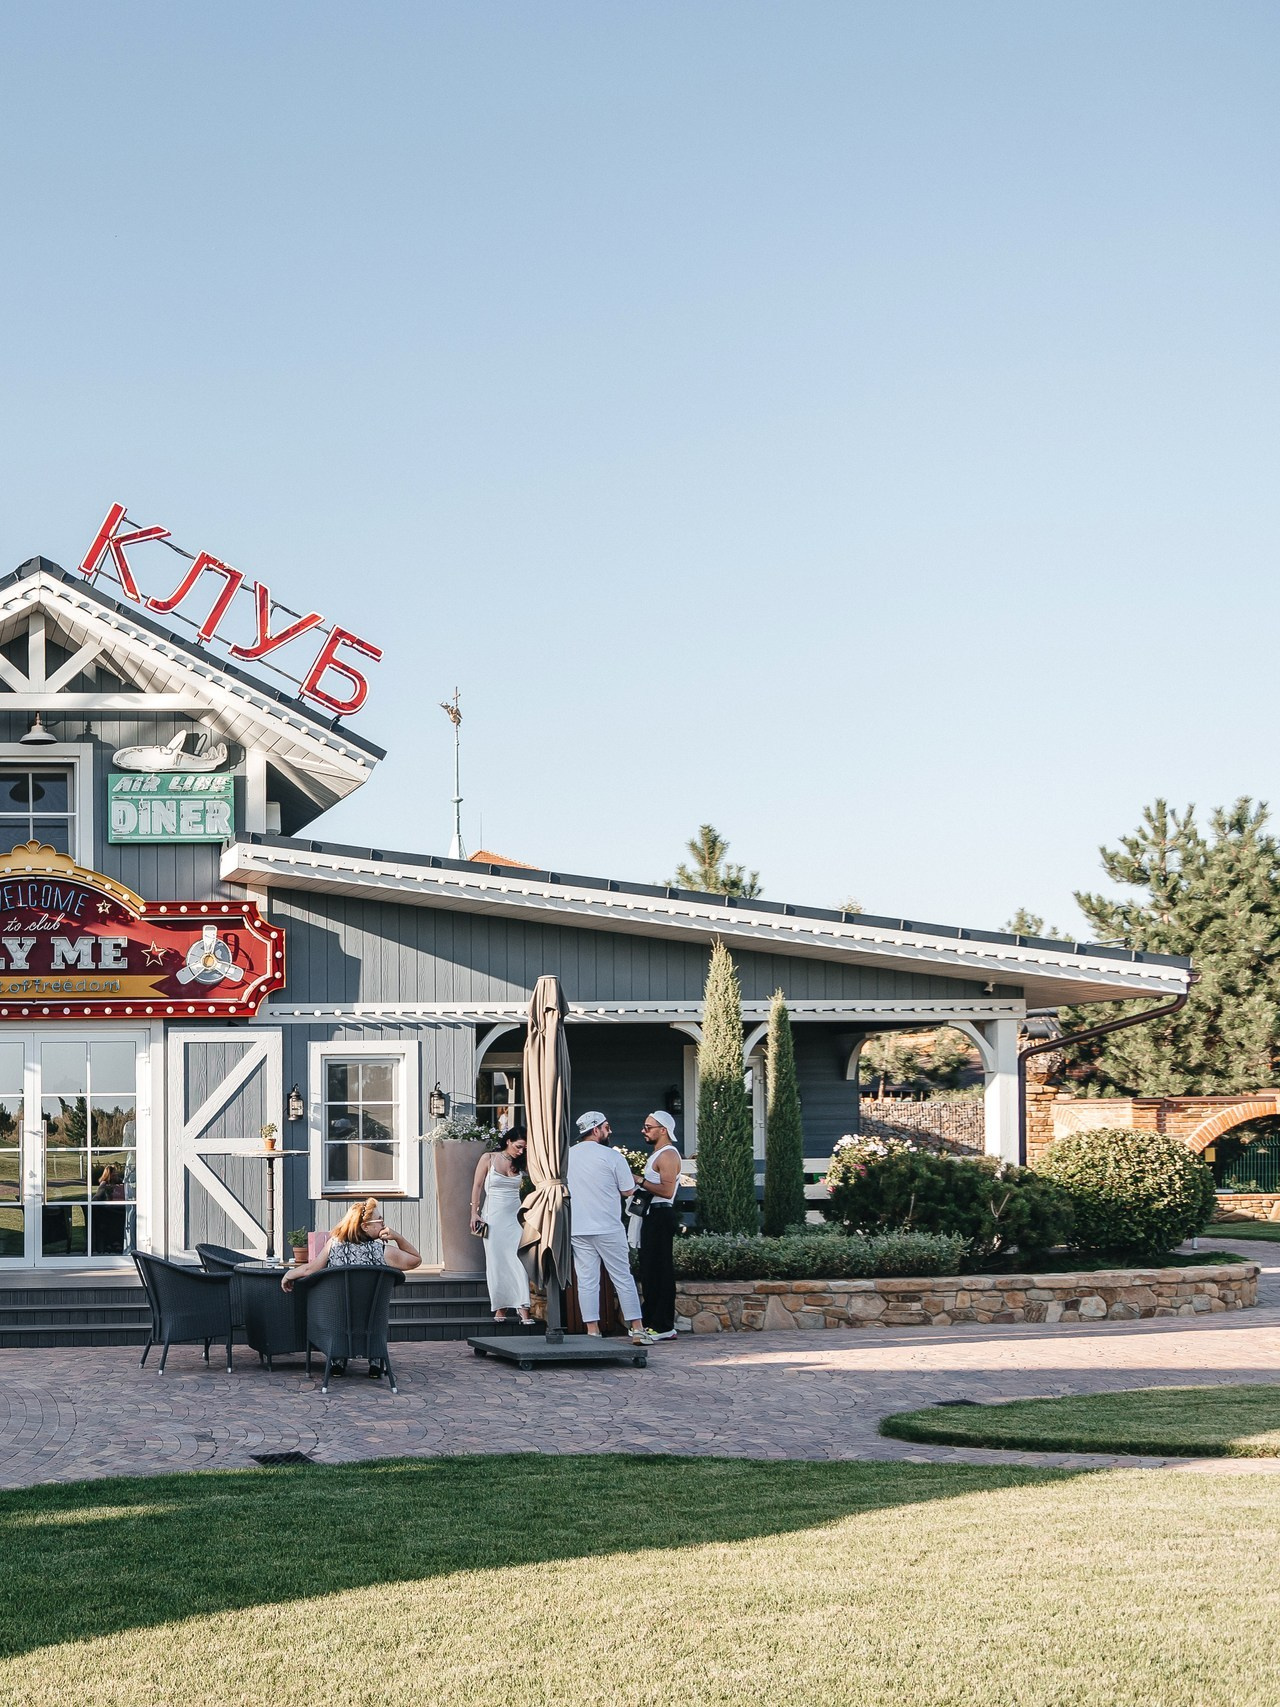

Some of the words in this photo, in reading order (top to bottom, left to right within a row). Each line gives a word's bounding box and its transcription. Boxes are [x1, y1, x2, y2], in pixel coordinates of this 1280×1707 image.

[77, 501, 385, 716] КЛУБ
[112, 776, 161, 792] AIR
[168, 775, 230, 792] LINE
[111, 800, 232, 835] DINER
[3, 917, 23, 932] to
[24, 912, 66, 932] club
[50, 936, 129, 971] ME
[8, 979, 28, 993] of
[33, 978, 120, 994] freedom
